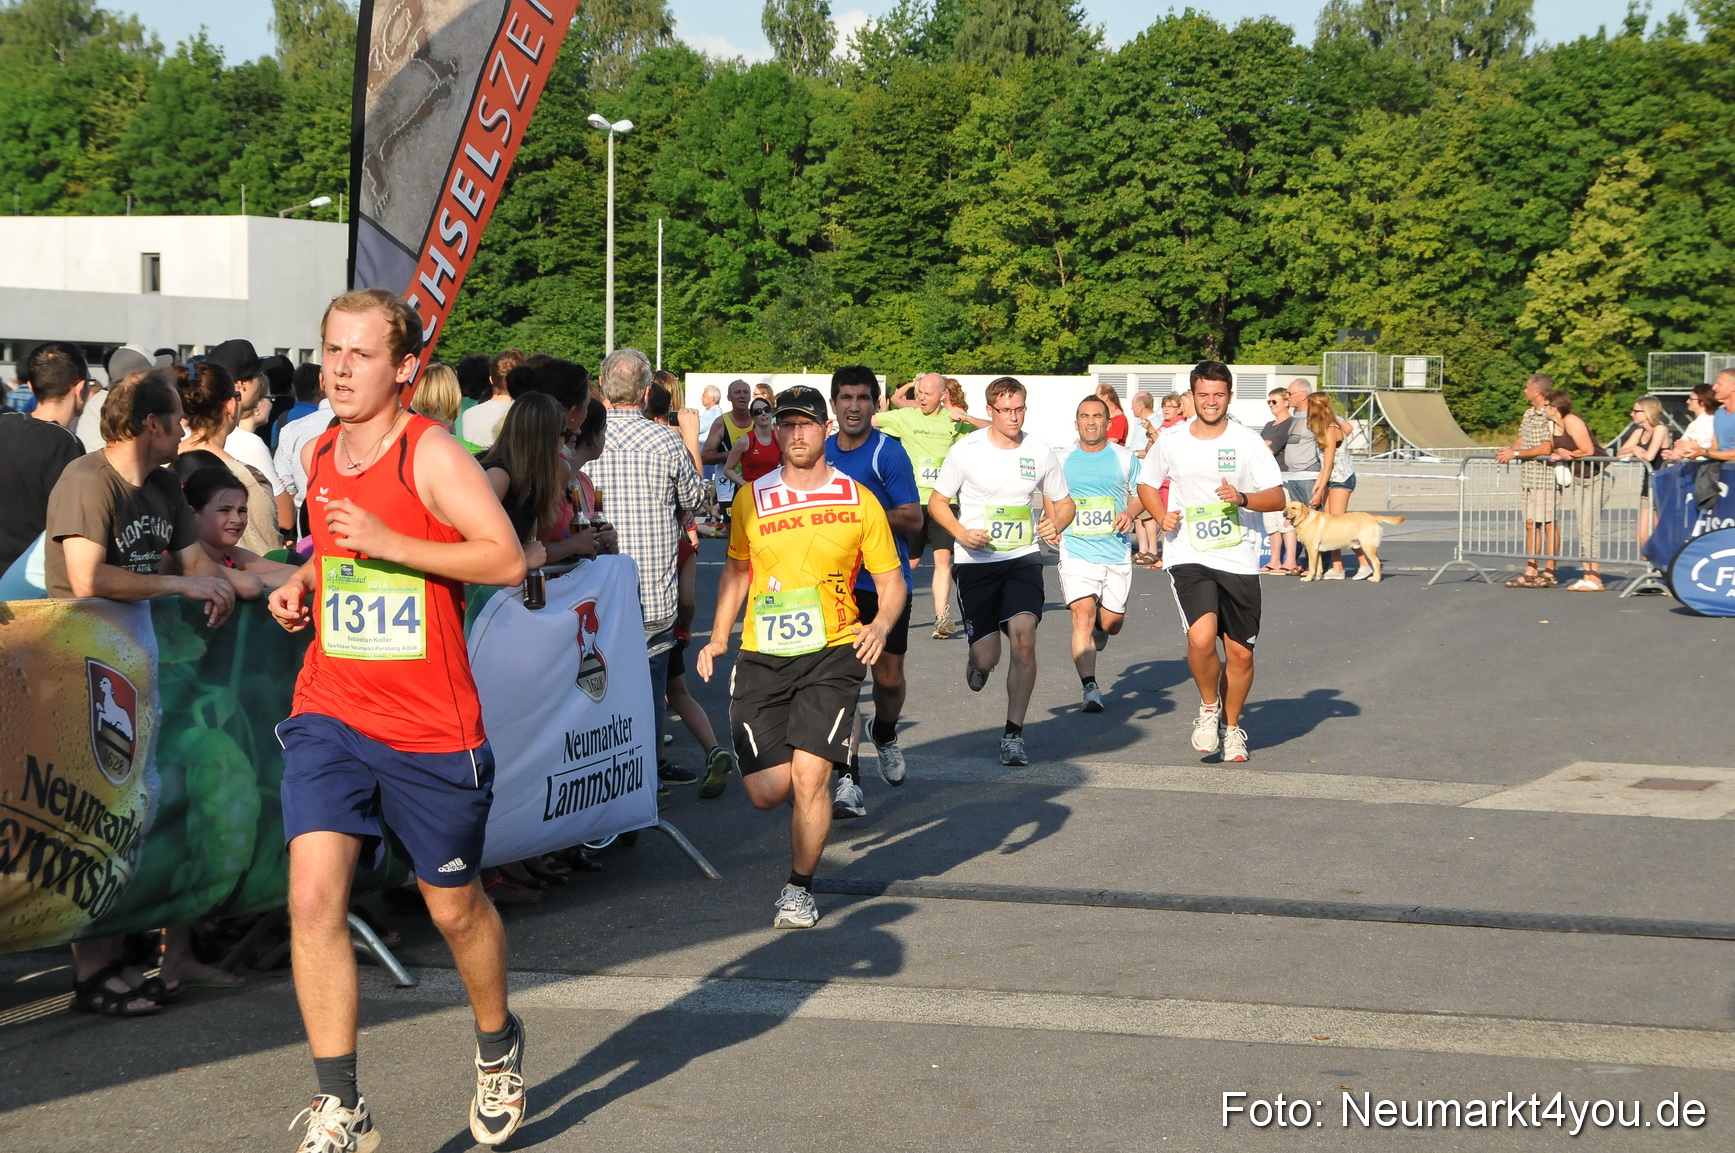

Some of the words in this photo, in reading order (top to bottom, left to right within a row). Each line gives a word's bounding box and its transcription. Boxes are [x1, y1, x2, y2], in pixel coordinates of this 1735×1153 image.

[921, 467, 941, 480] 44
[759, 515, 805, 536] MAX
[810, 509, 861, 526] BÖGL
[990, 521, 1023, 540] 871
[1075, 510, 1113, 527] 1384
[1195, 516, 1232, 540] 865
[325, 592, 421, 634] 1314
[761, 611, 813, 641] 753
[327, 642, 350, 650] Sparkasse
[347, 635, 372, 643] Sebastian
[585, 675, 604, 693] 1628
[563, 713, 633, 764] Neumarkter
[102, 749, 125, 776] 1628
[542, 748, 643, 822] Lammsbräu
